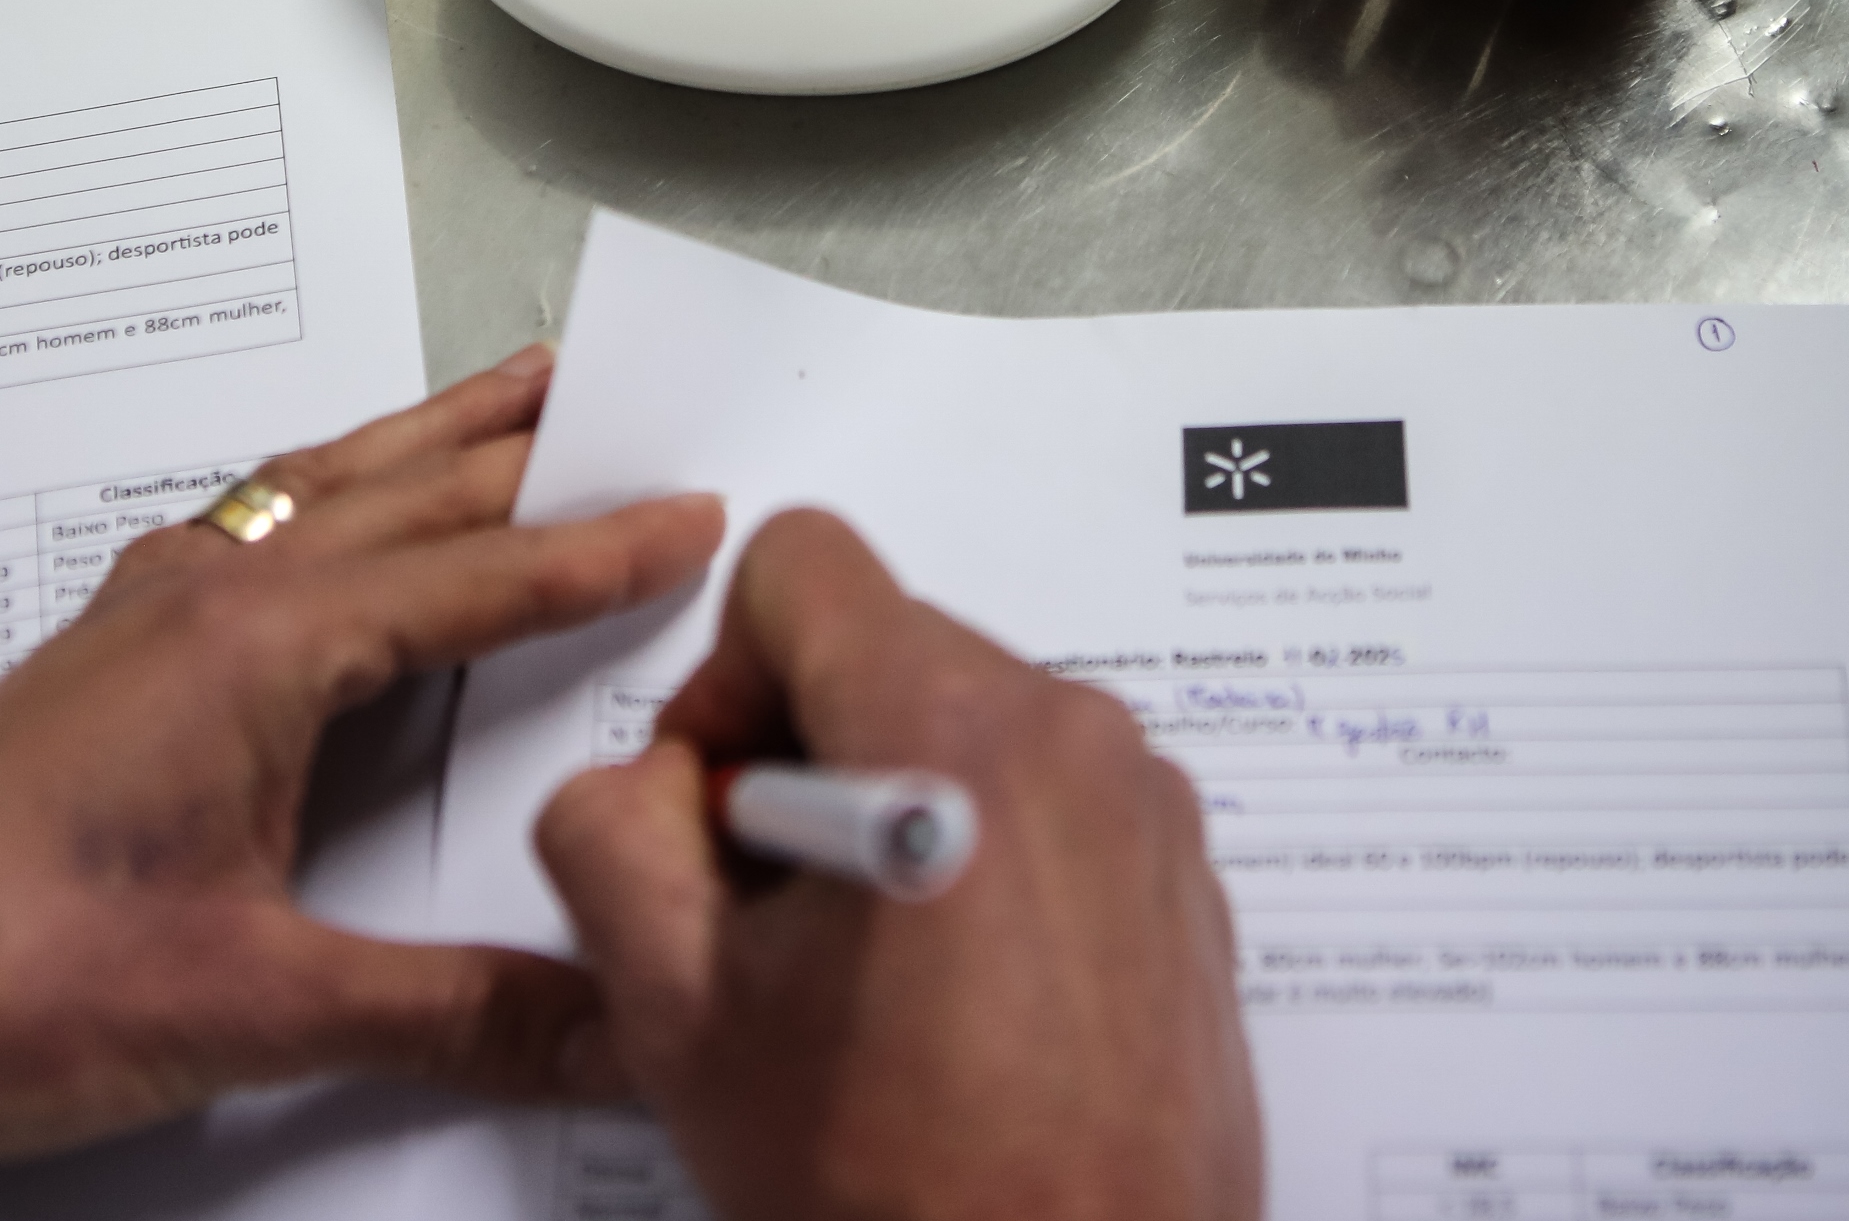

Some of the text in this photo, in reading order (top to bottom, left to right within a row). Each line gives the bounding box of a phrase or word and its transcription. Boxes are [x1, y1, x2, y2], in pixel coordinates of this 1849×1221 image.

[108, 231, 221, 262] desportista
[228, 221, 279, 245] pode
[36, 326, 115, 351] homem
[124, 324, 136, 337] e
[144, 313, 201, 335] 88cm
[209, 298, 287, 325] mulher,
[99, 469, 239, 504] Classificação
[52, 512, 165, 542] Baixo Peso
[53, 553, 102, 573] Peso
